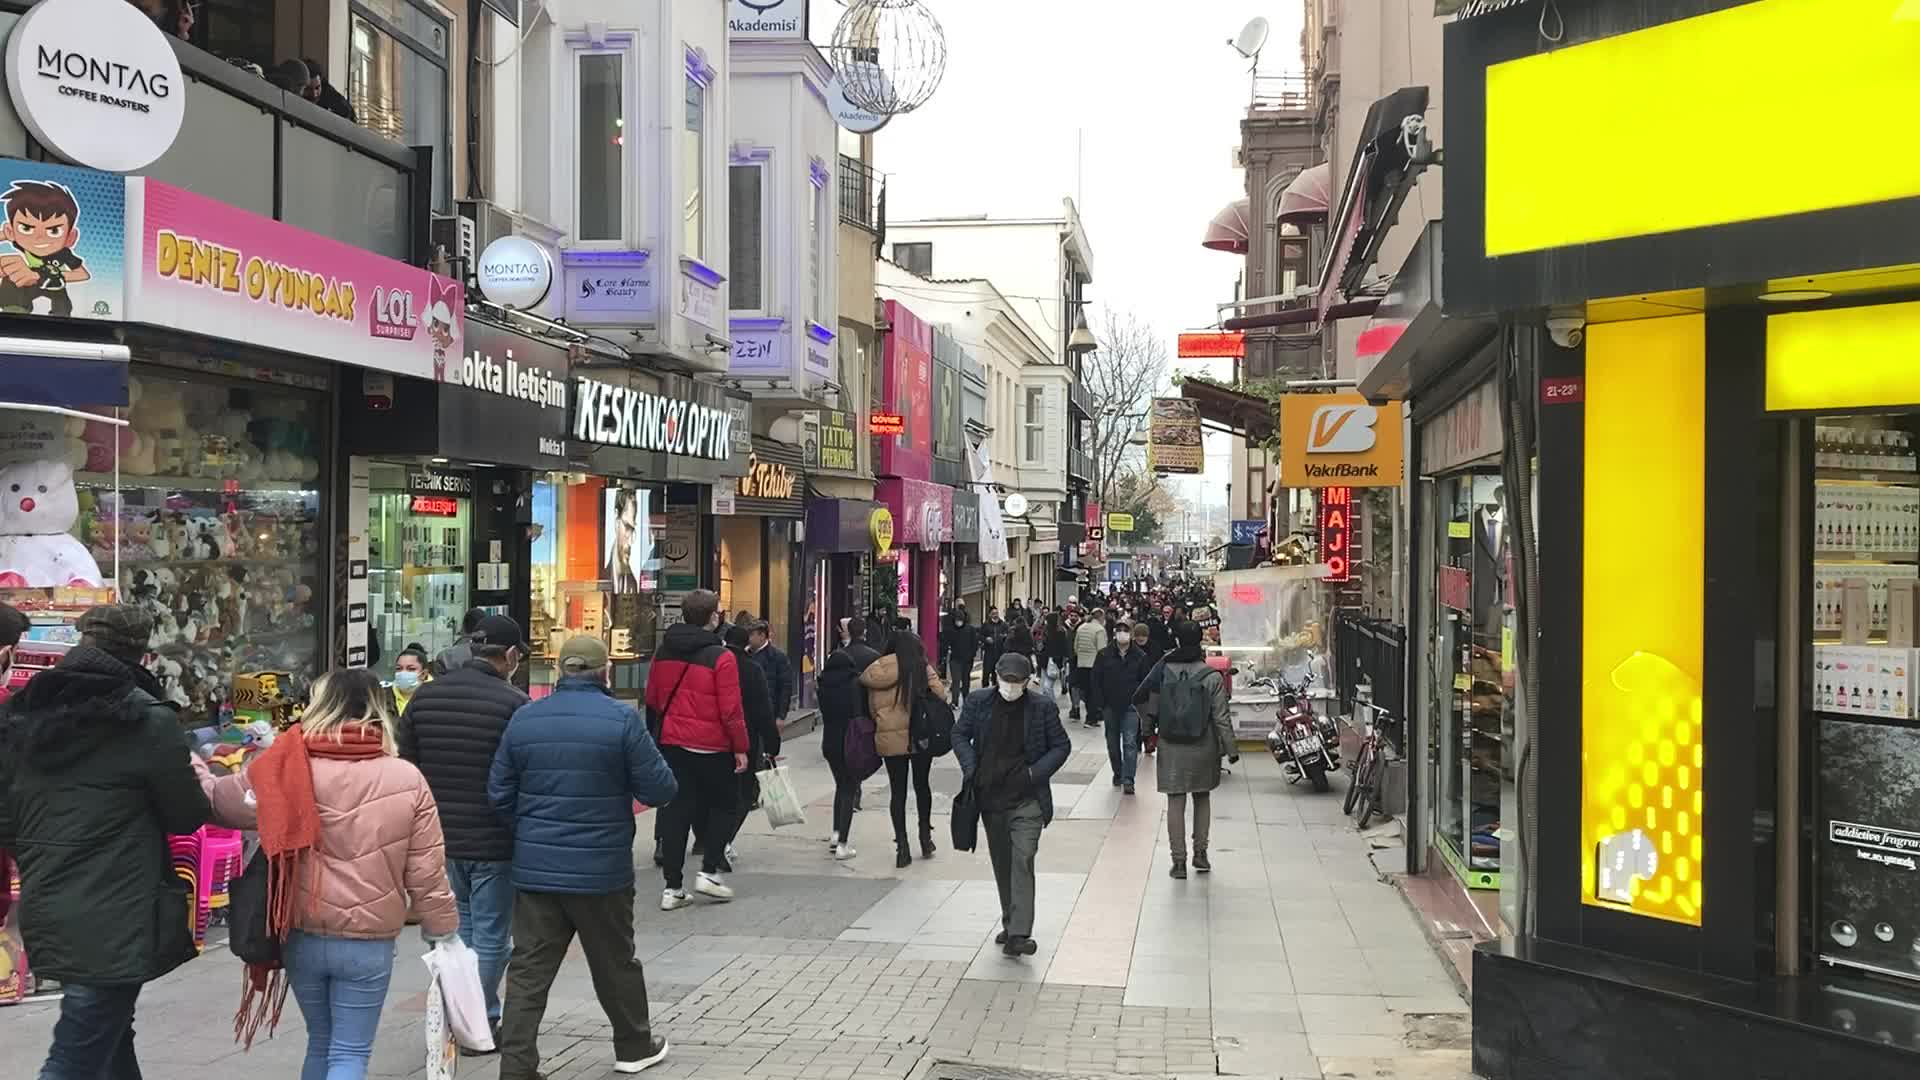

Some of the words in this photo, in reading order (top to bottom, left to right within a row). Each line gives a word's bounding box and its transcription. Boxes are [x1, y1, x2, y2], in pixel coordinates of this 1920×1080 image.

[729, 19, 797, 32] Akademisi
[38, 44, 169, 98] MONTAG
[58, 84, 98, 103] COFFEE
[100, 94, 150, 113] ROASTERS
[246, 256, 356, 322] OYUNCAK
[484, 263, 539, 276] MONTAG
[376, 287, 417, 326] LOL
[463, 350, 502, 394] okta
[506, 349, 566, 409] İletişim
[1327, 487, 1346, 576] MAJO
[1834, 826, 1880, 843] addictive
